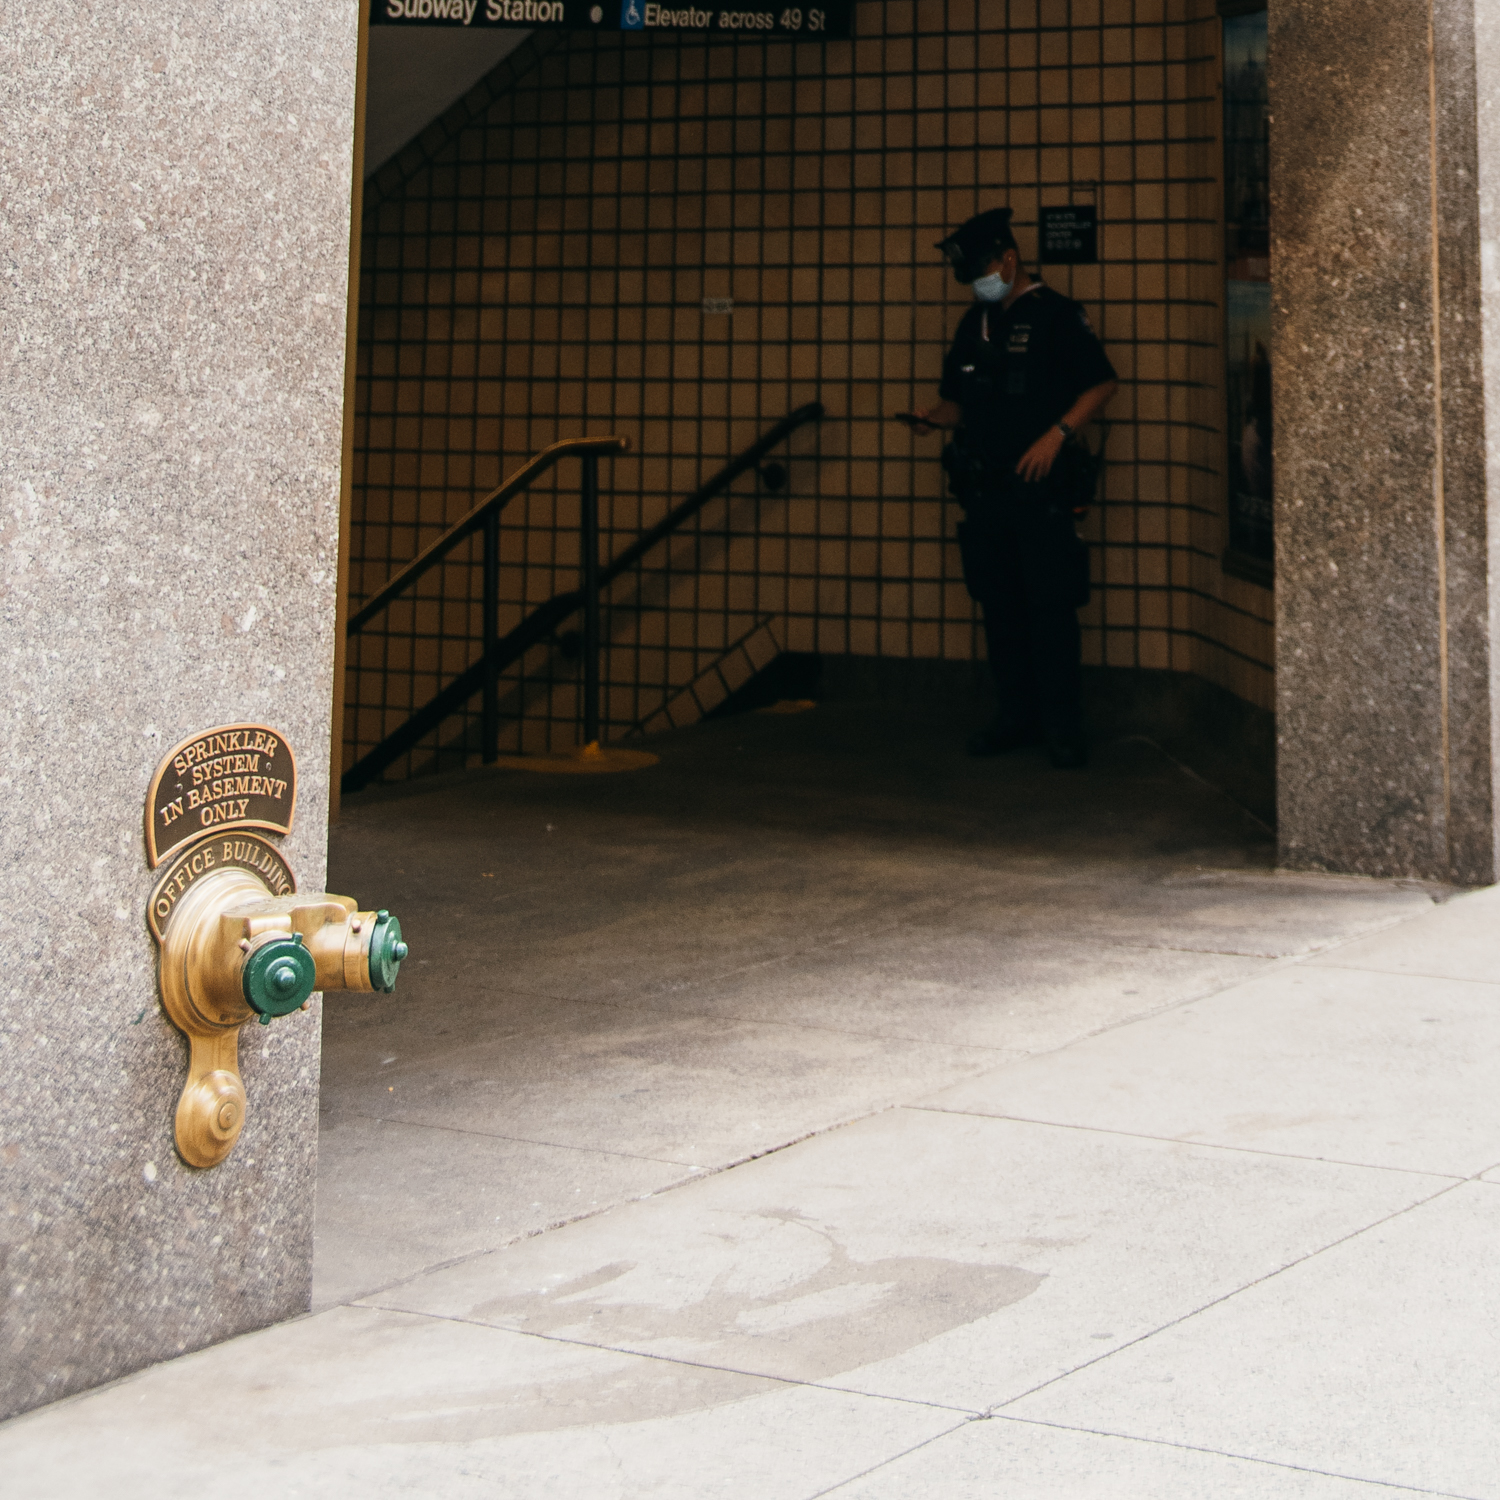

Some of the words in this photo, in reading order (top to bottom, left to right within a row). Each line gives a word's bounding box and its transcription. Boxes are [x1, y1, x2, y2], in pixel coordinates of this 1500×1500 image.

[644, 2, 713, 28] Elevator
[718, 10, 774, 30] across
[780, 8, 802, 30] 49
[808, 9, 826, 31] St
[174, 730, 278, 777] SPRINKLER
[192, 754, 260, 786] SYSTEM
[159, 797, 185, 827] IN
[187, 776, 287, 810] BASEMENT
[200, 799, 250, 827] ONLY
[156, 846, 216, 918] OFFICE
